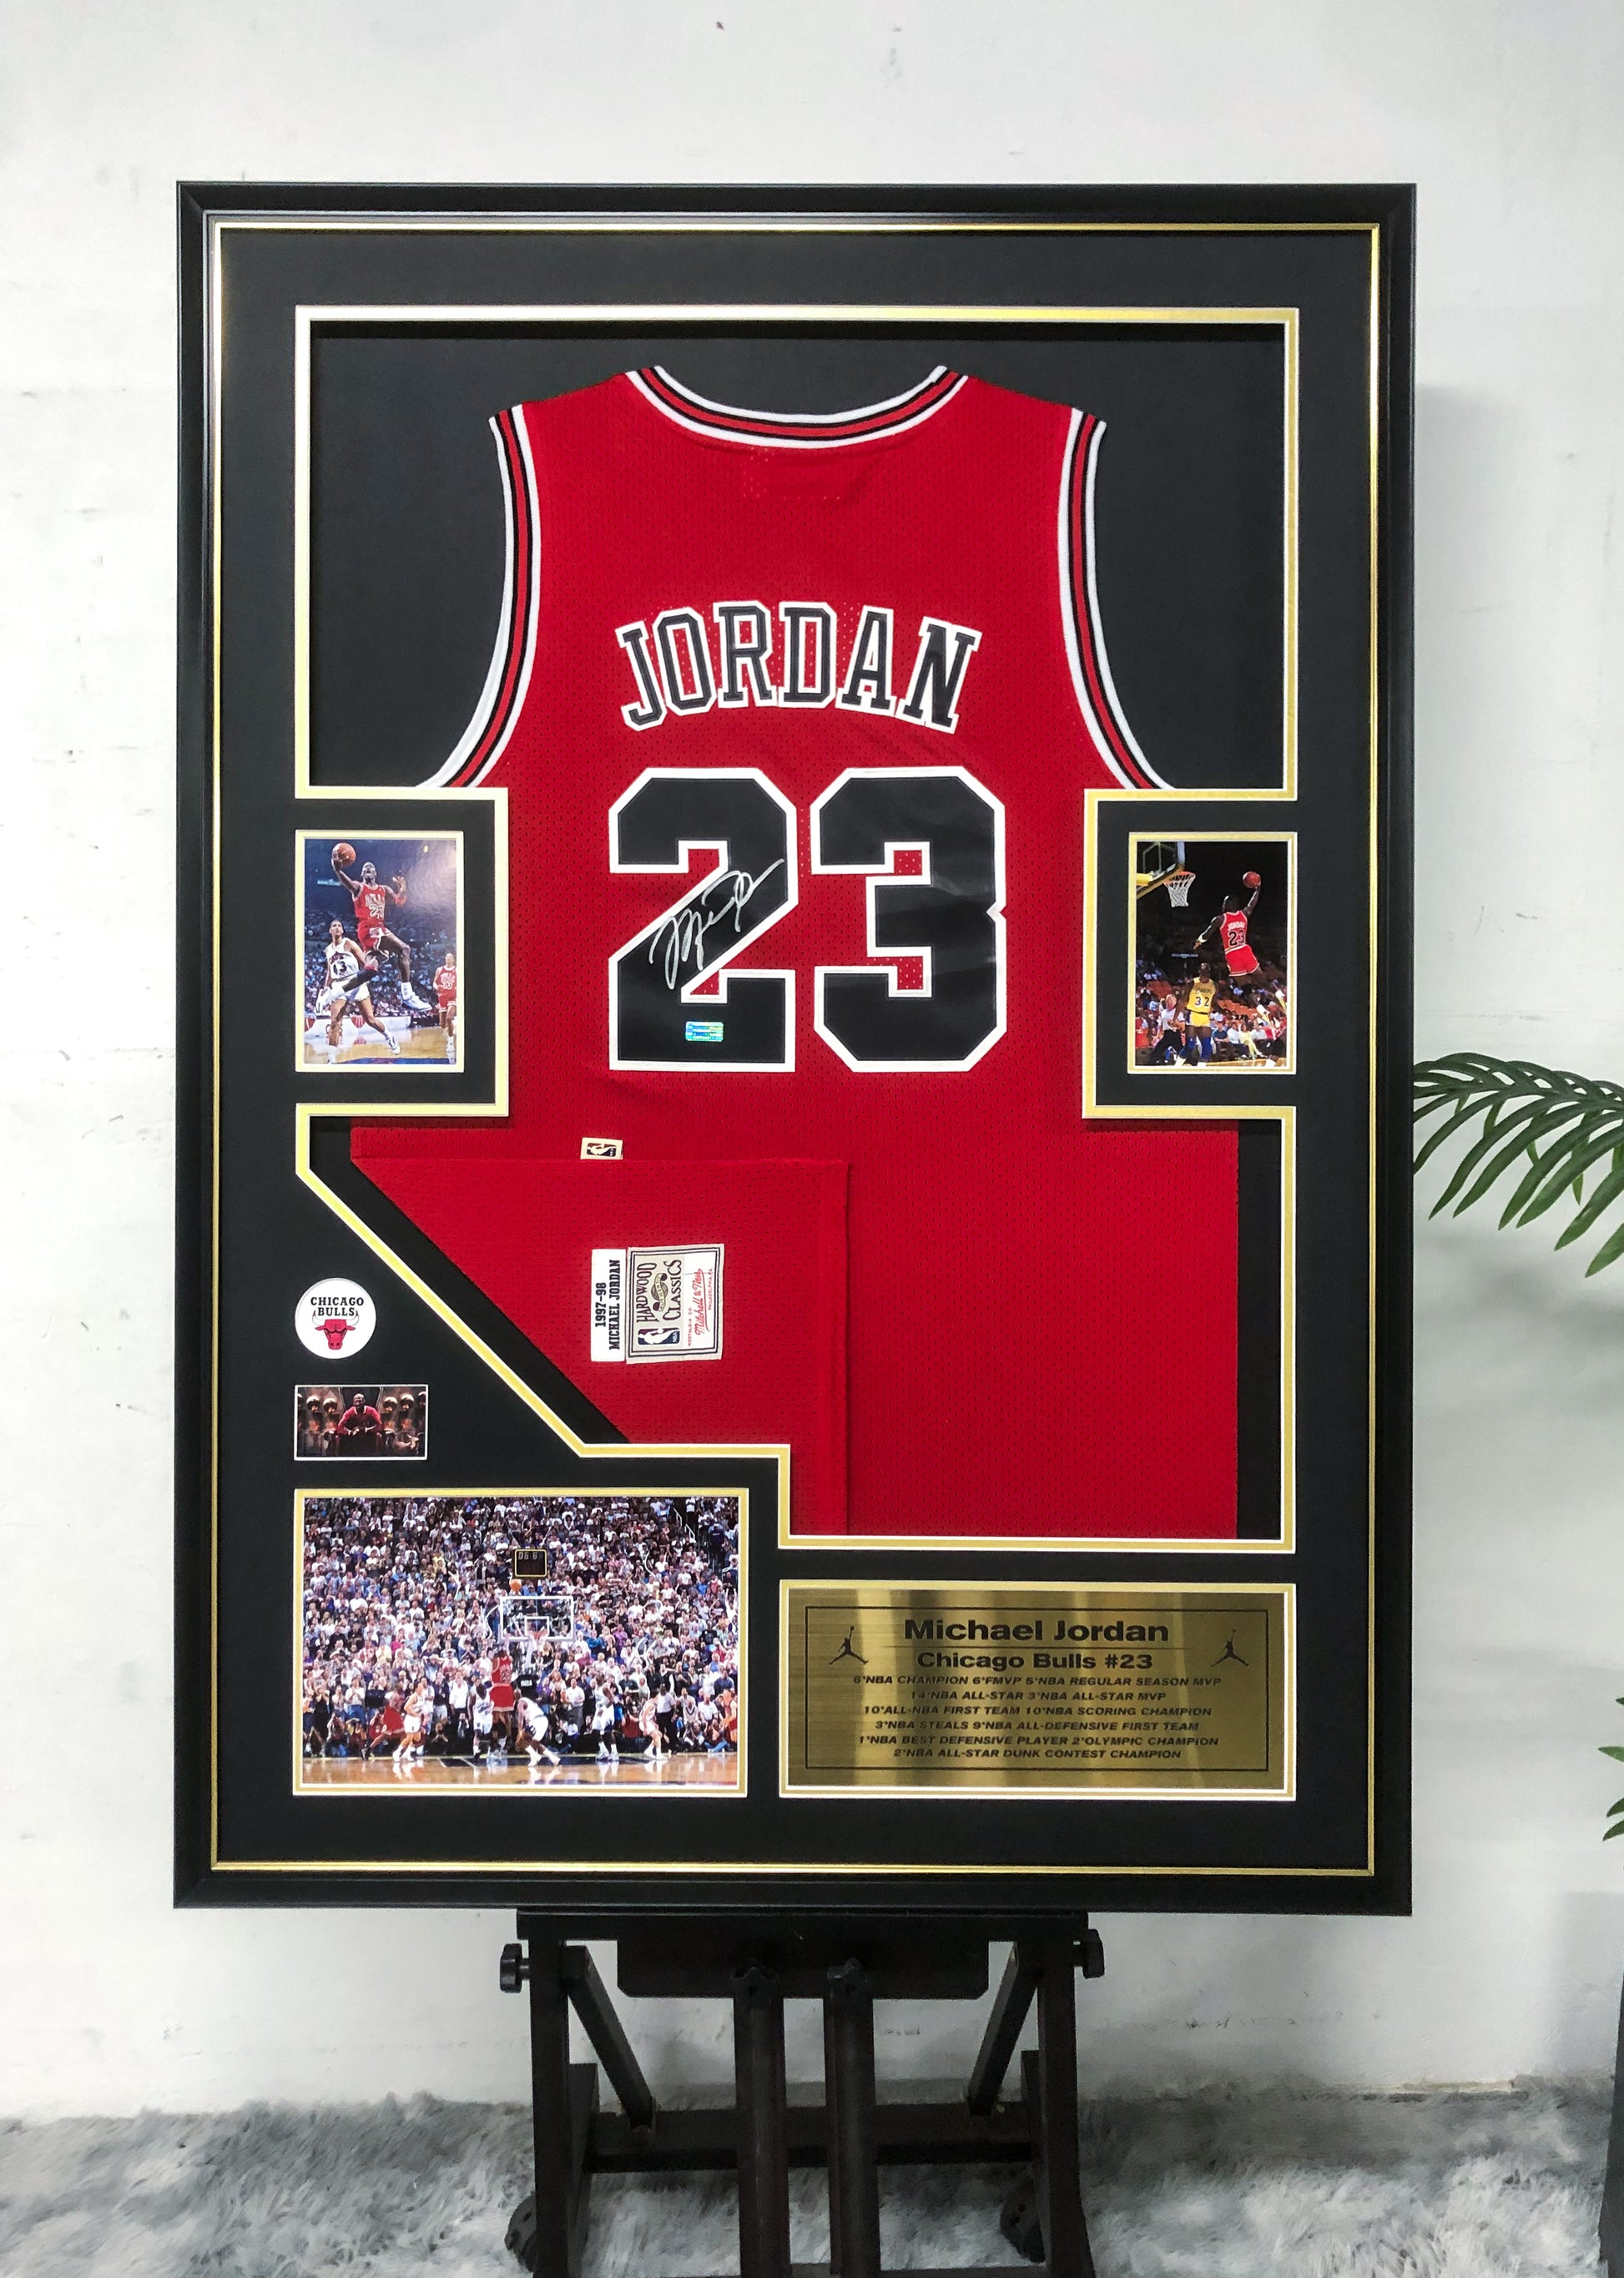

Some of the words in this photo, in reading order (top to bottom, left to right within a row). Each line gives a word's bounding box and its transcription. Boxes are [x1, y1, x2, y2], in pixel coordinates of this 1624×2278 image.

[615, 600, 982, 734] JORDAN
[608, 765, 1006, 1073] 23
[1228, 929, 1246, 947] 23
[1195, 996, 1210, 1008] 32
[608, 1259, 620, 1301] JORDAN
[636, 1262, 659, 1323] HARDWOOD
[663, 1259, 682, 1321] CLASSICS
[310, 1296, 364, 1306] CHICAGO
[595, 1282, 607, 1327] 1997-98
[317, 1307, 355, 1316] BULLS
[693, 1297, 705, 1336] Mitchell
[608, 1303, 620, 1350] MICHAEL
[905, 1619, 1042, 1641] Michael
[1054, 1620, 1168, 1642] Jordan
[918, 1652, 1025, 1672] Chicago
[1033, 1653, 1097, 1669] Bulls
[1105, 1654, 1152, 1669] #23
[897, 1675, 969, 1685] CHAMPION
[1069, 1677, 1132, 1686] REGULAR
[1136, 1677, 1189, 1686] SEASON
[1193, 1678, 1222, 1686] MVP
[961, 1691, 1024, 1700] ALL-STAR
[1072, 1692, 1133, 1701] ALL-STAR
[1137, 1692, 1167, 1701] MVP
[943, 1706, 981, 1715] FIRST
[984, 1707, 1020, 1715] TEAM
[1077, 1707, 1137, 1716] SCORING
[1141, 1707, 1212, 1716] CHAMPION
[920, 1721, 969, 1730] STEALS
[1016, 1721, 1118, 1730] ALL-DEFENSIVE
[1122, 1722, 1159, 1730] FIRST
[1163, 1722, 1199, 1730] TEAM
[902, 1736, 936, 1745] BEST
[940, 1736, 1013, 1745] DEFENSIVE
[1016, 1736, 1068, 1745] PLAYER
[1147, 1737, 1219, 1746] CHAMPION
[937, 1749, 1000, 1758] ALL-STAR
[1003, 1750, 1041, 1758] DUNK
[1044, 1750, 1107, 1759] CONTEST
[1110, 1750, 1182, 1759] CHAMPION
